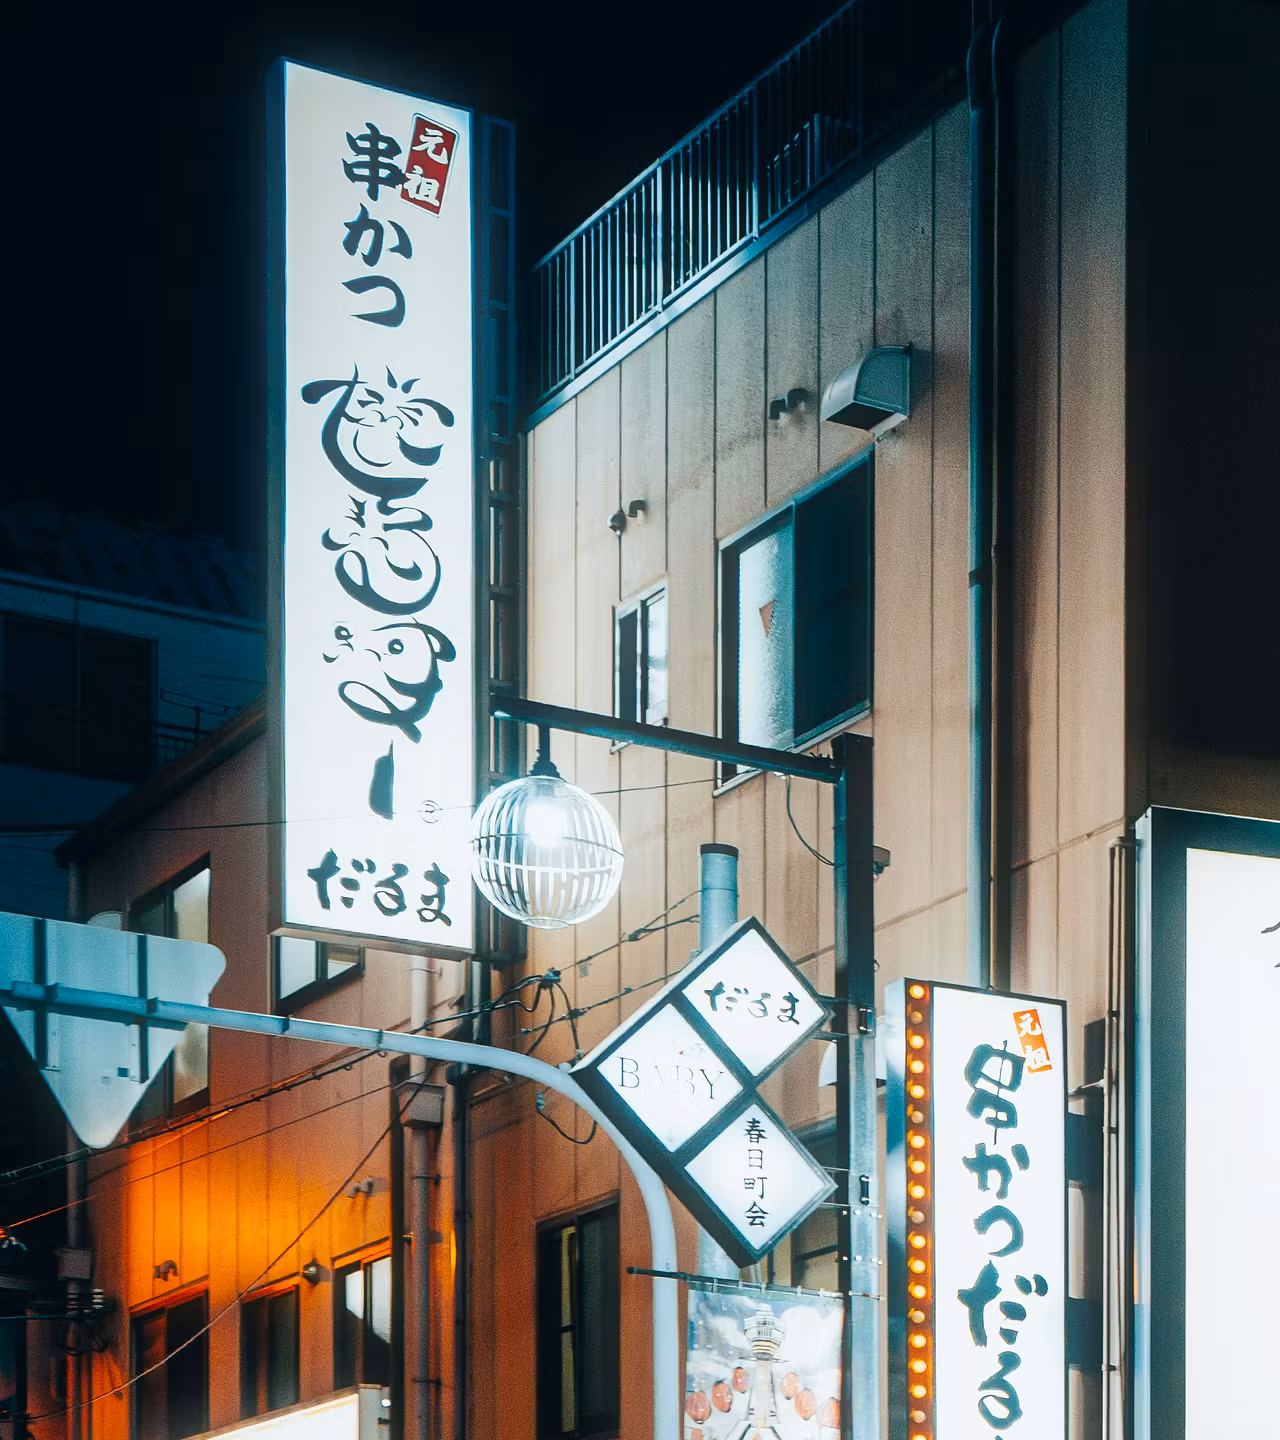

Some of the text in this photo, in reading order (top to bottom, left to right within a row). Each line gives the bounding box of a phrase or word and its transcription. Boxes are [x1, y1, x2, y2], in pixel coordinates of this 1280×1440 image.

[404, 127, 450, 207] 元祖
[341, 122, 414, 328] 串かつ
[307, 848, 452, 926] だるま
[704, 981, 800, 1025] だるま
[1016, 1013, 1052, 1070] 元祖
[743, 1117, 769, 1228] 春日町会
